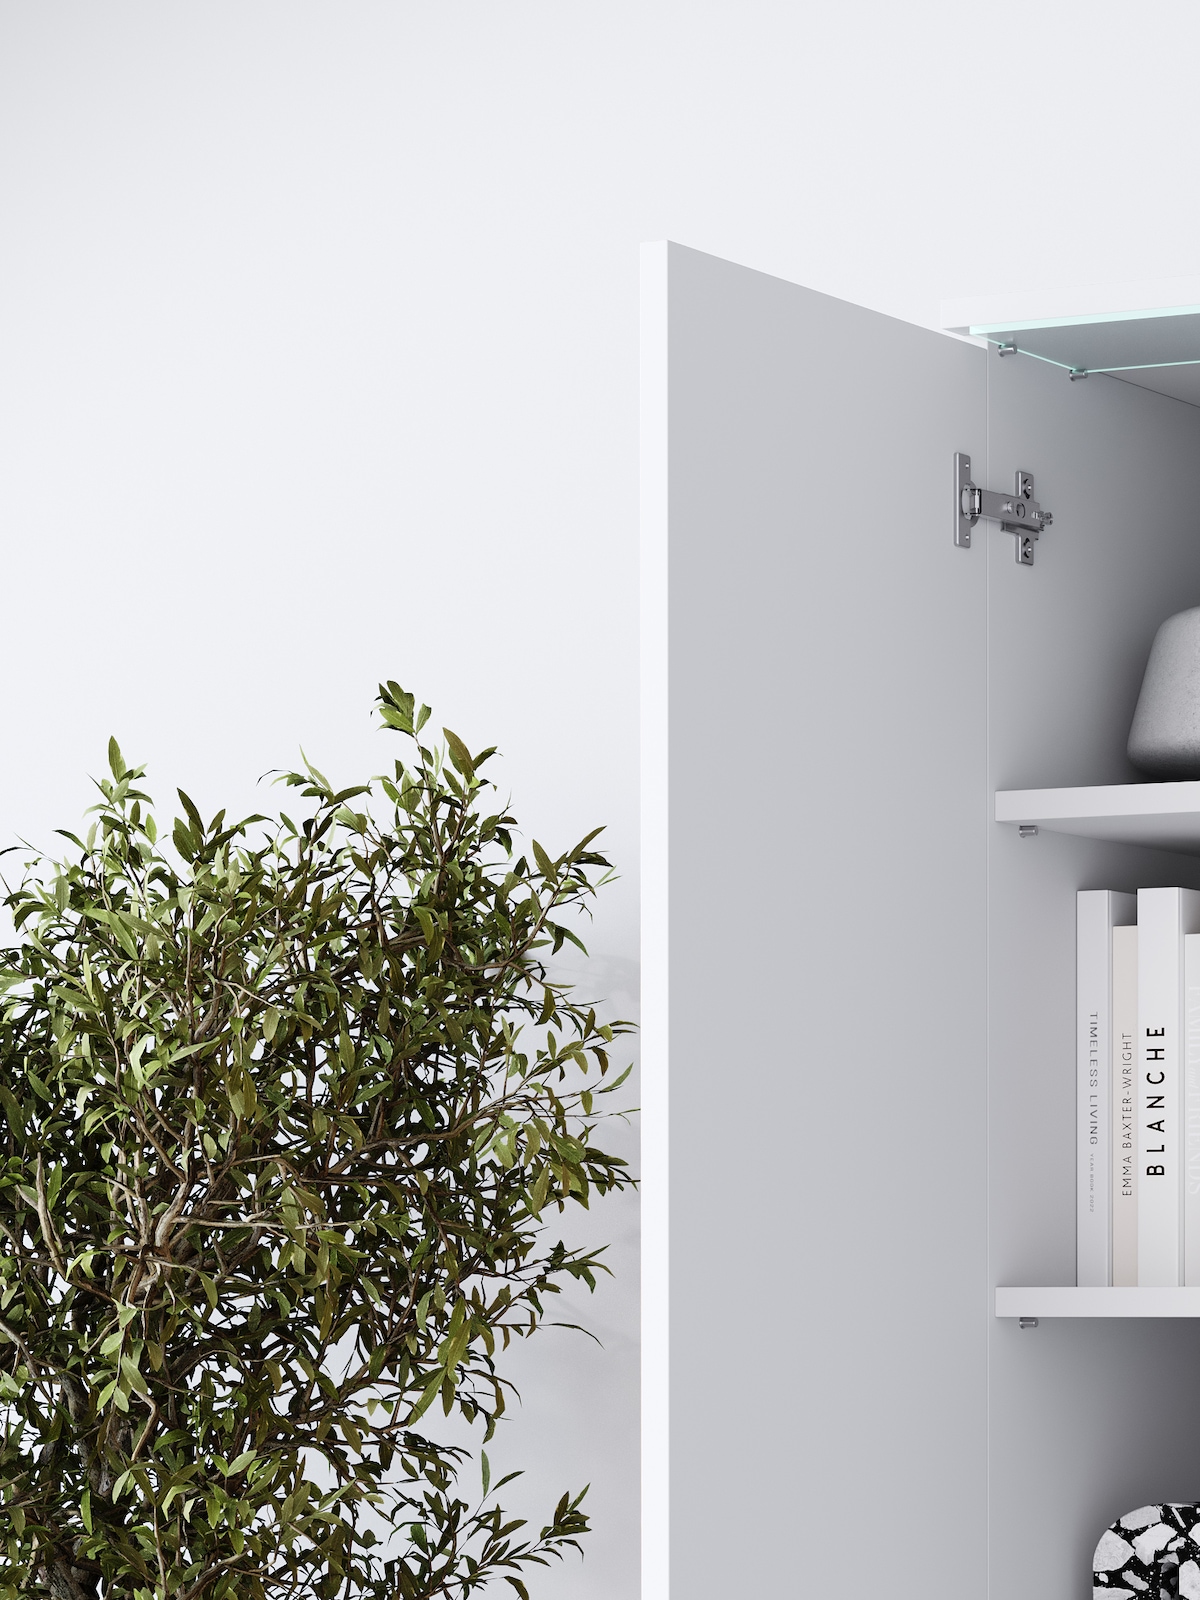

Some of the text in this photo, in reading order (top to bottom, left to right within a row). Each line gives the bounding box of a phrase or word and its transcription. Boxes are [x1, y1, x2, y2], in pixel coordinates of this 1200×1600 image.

[1089, 1012, 1098, 1145] TIMELESS LIVING
[1122, 1033, 1132, 1196] EMMA BAXTER-WRIGHT
[1146, 1027, 1165, 1176] BLANCHE
